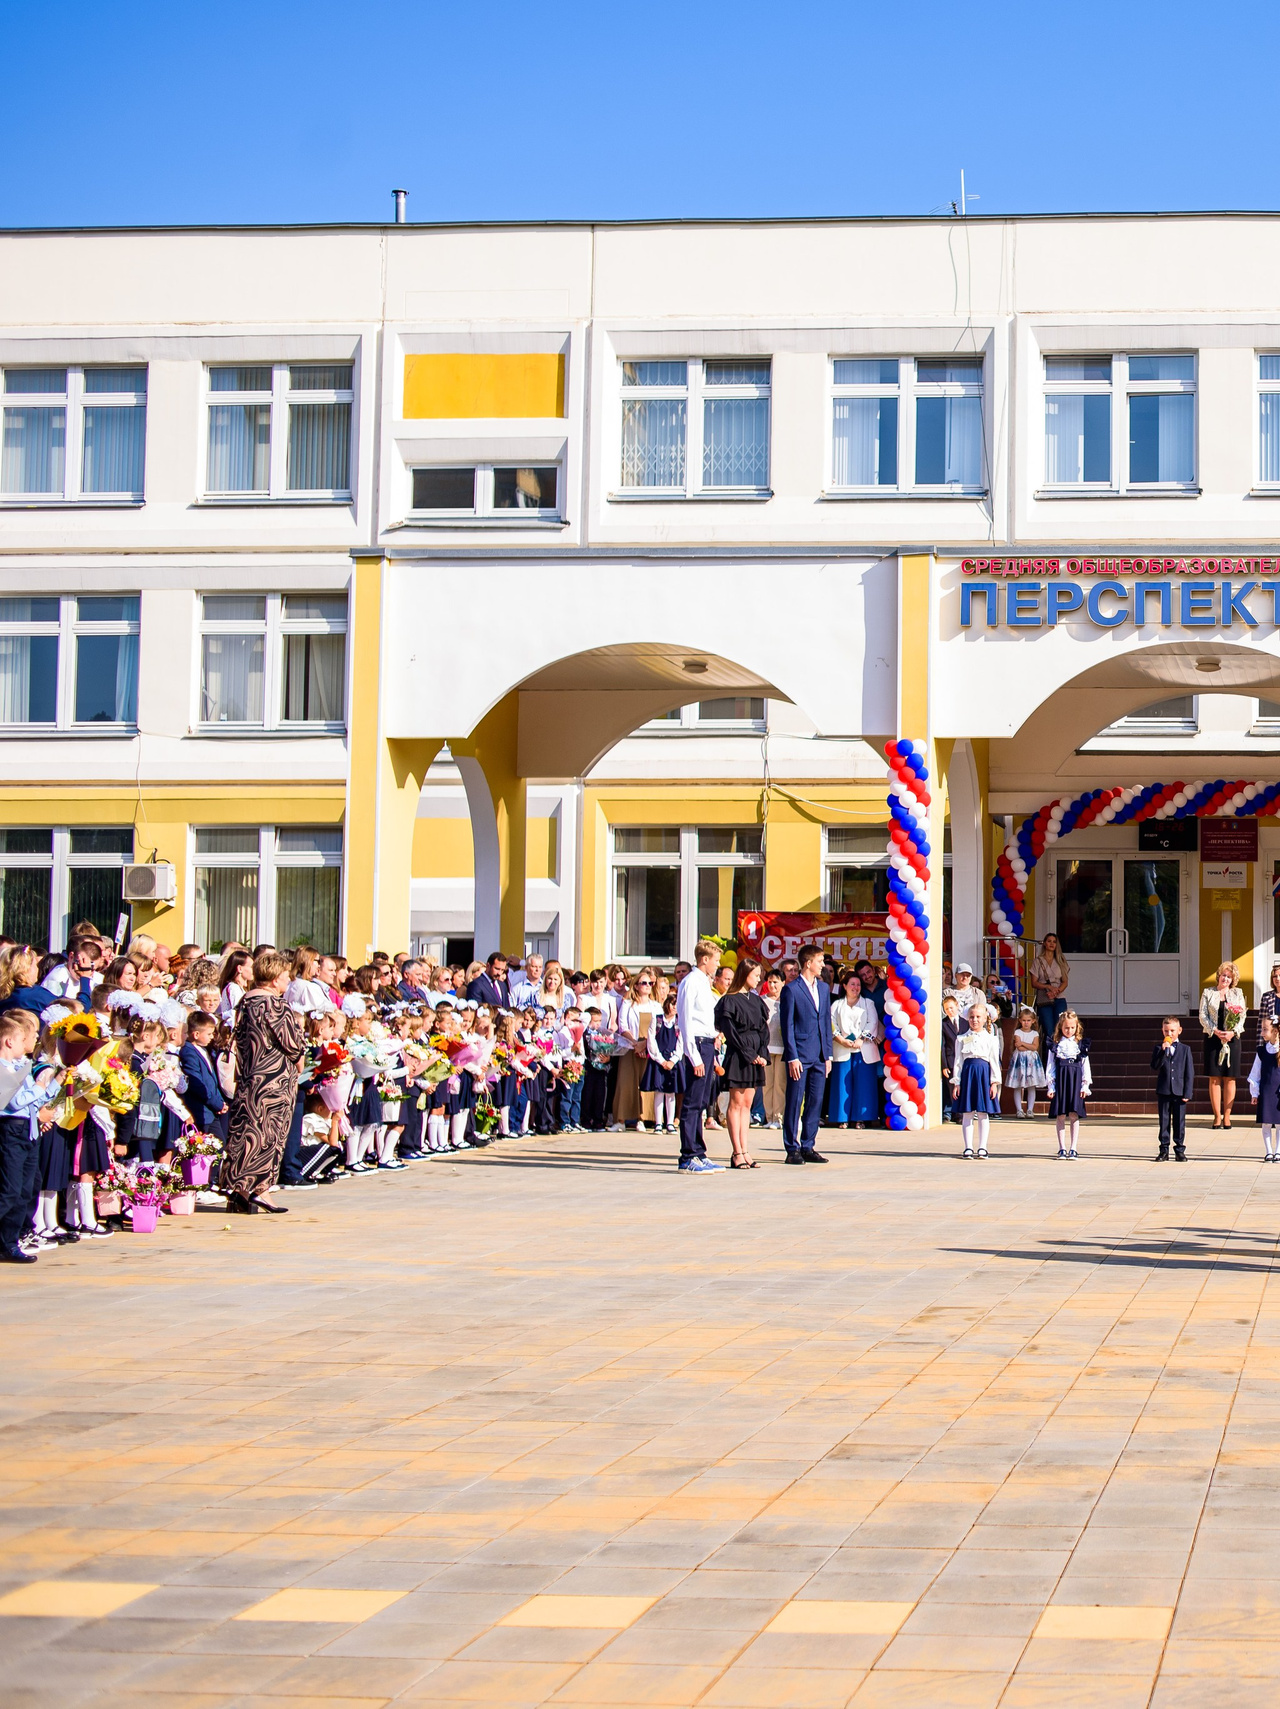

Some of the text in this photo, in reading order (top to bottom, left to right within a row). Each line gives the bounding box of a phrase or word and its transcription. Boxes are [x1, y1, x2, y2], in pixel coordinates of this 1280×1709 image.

[961, 558, 1060, 577] СРЕДНЯЯ
[747, 920, 757, 939] 1
[760, 936, 888, 960] СЕНТЯБ
